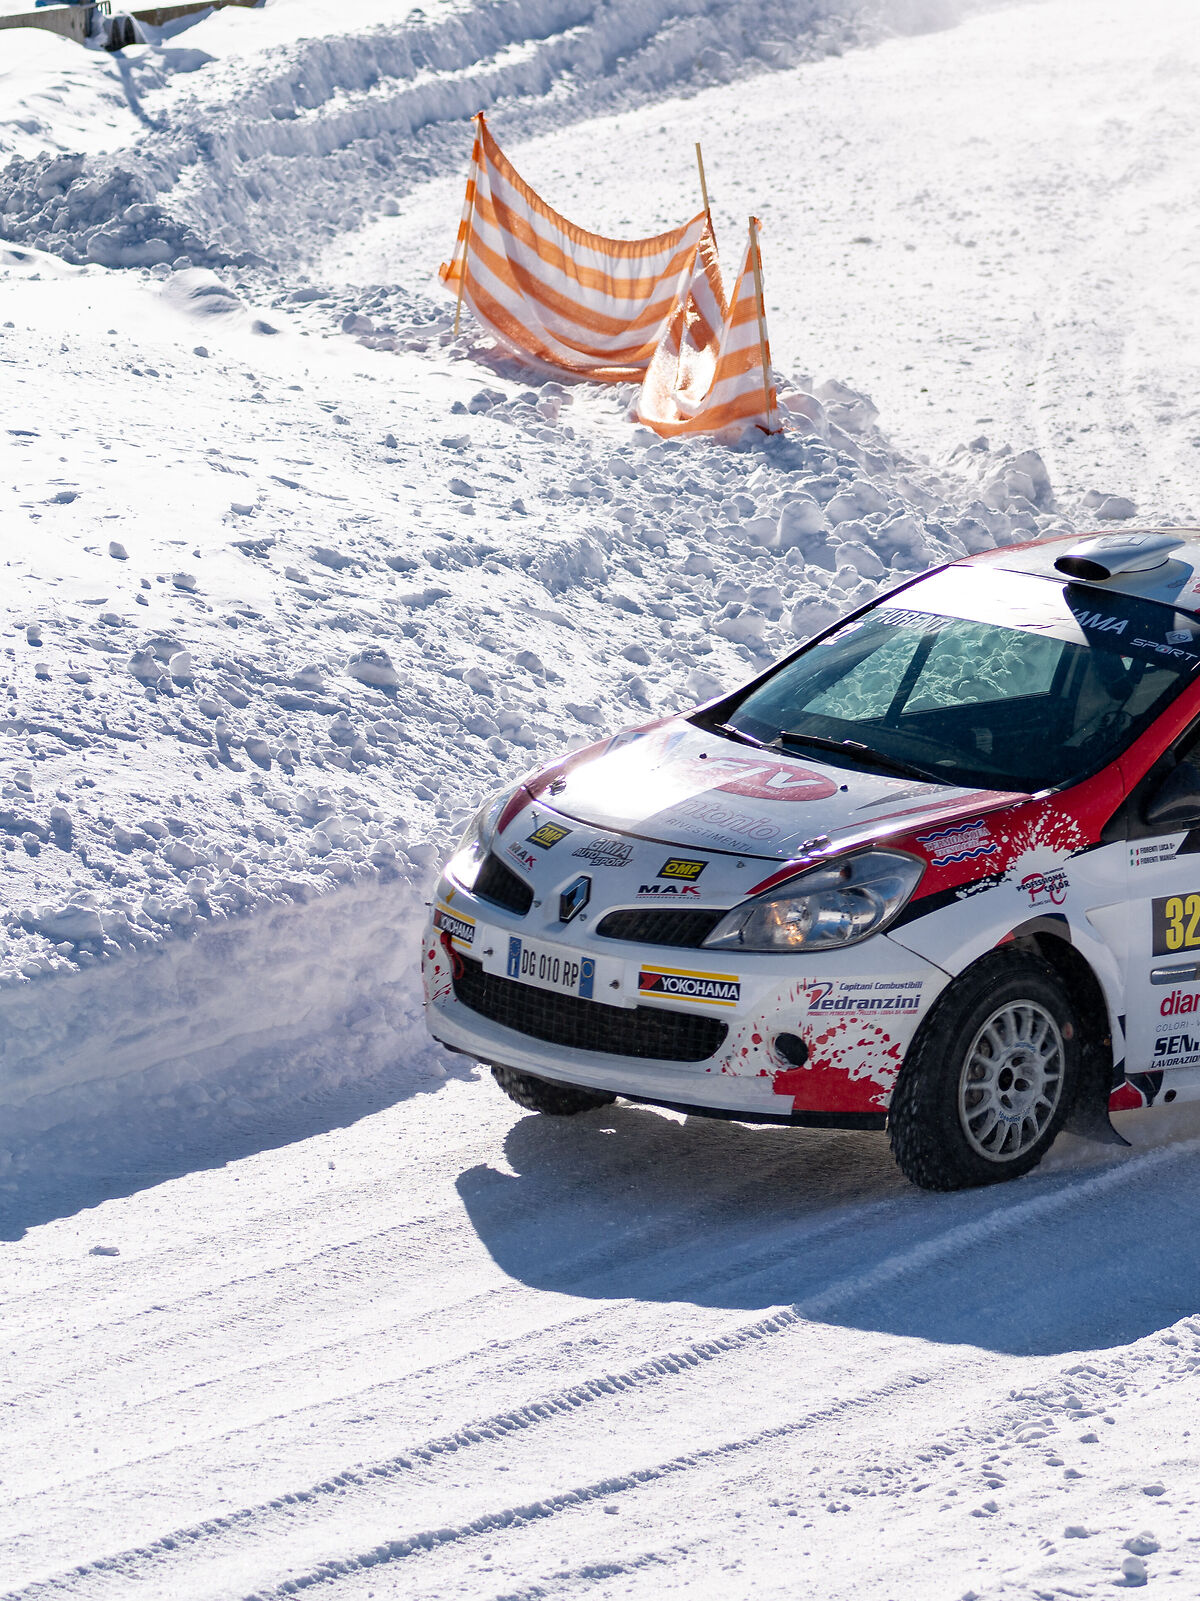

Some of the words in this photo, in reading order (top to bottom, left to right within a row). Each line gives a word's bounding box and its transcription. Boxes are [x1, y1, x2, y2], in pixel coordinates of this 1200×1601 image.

[1130, 638, 1198, 661] SPORT
[694, 759, 826, 789] FIV
[534, 827, 563, 842] OMP
[586, 838, 634, 860] GIMA
[590, 856, 634, 868] SPORT
[664, 864, 701, 876] OMP
[1016, 872, 1067, 891] PROFESSIONAL
[1044, 880, 1071, 892] COLOR
[638, 885, 701, 895] MAK
[521, 949, 536, 976] DG
[539, 955, 560, 983] 010
[661, 977, 739, 999] YOKOHAMA
[839, 982, 873, 992] Capitani
[875, 981, 923, 990] Combustibili
[1156, 1021, 1189, 1033] COLORI
